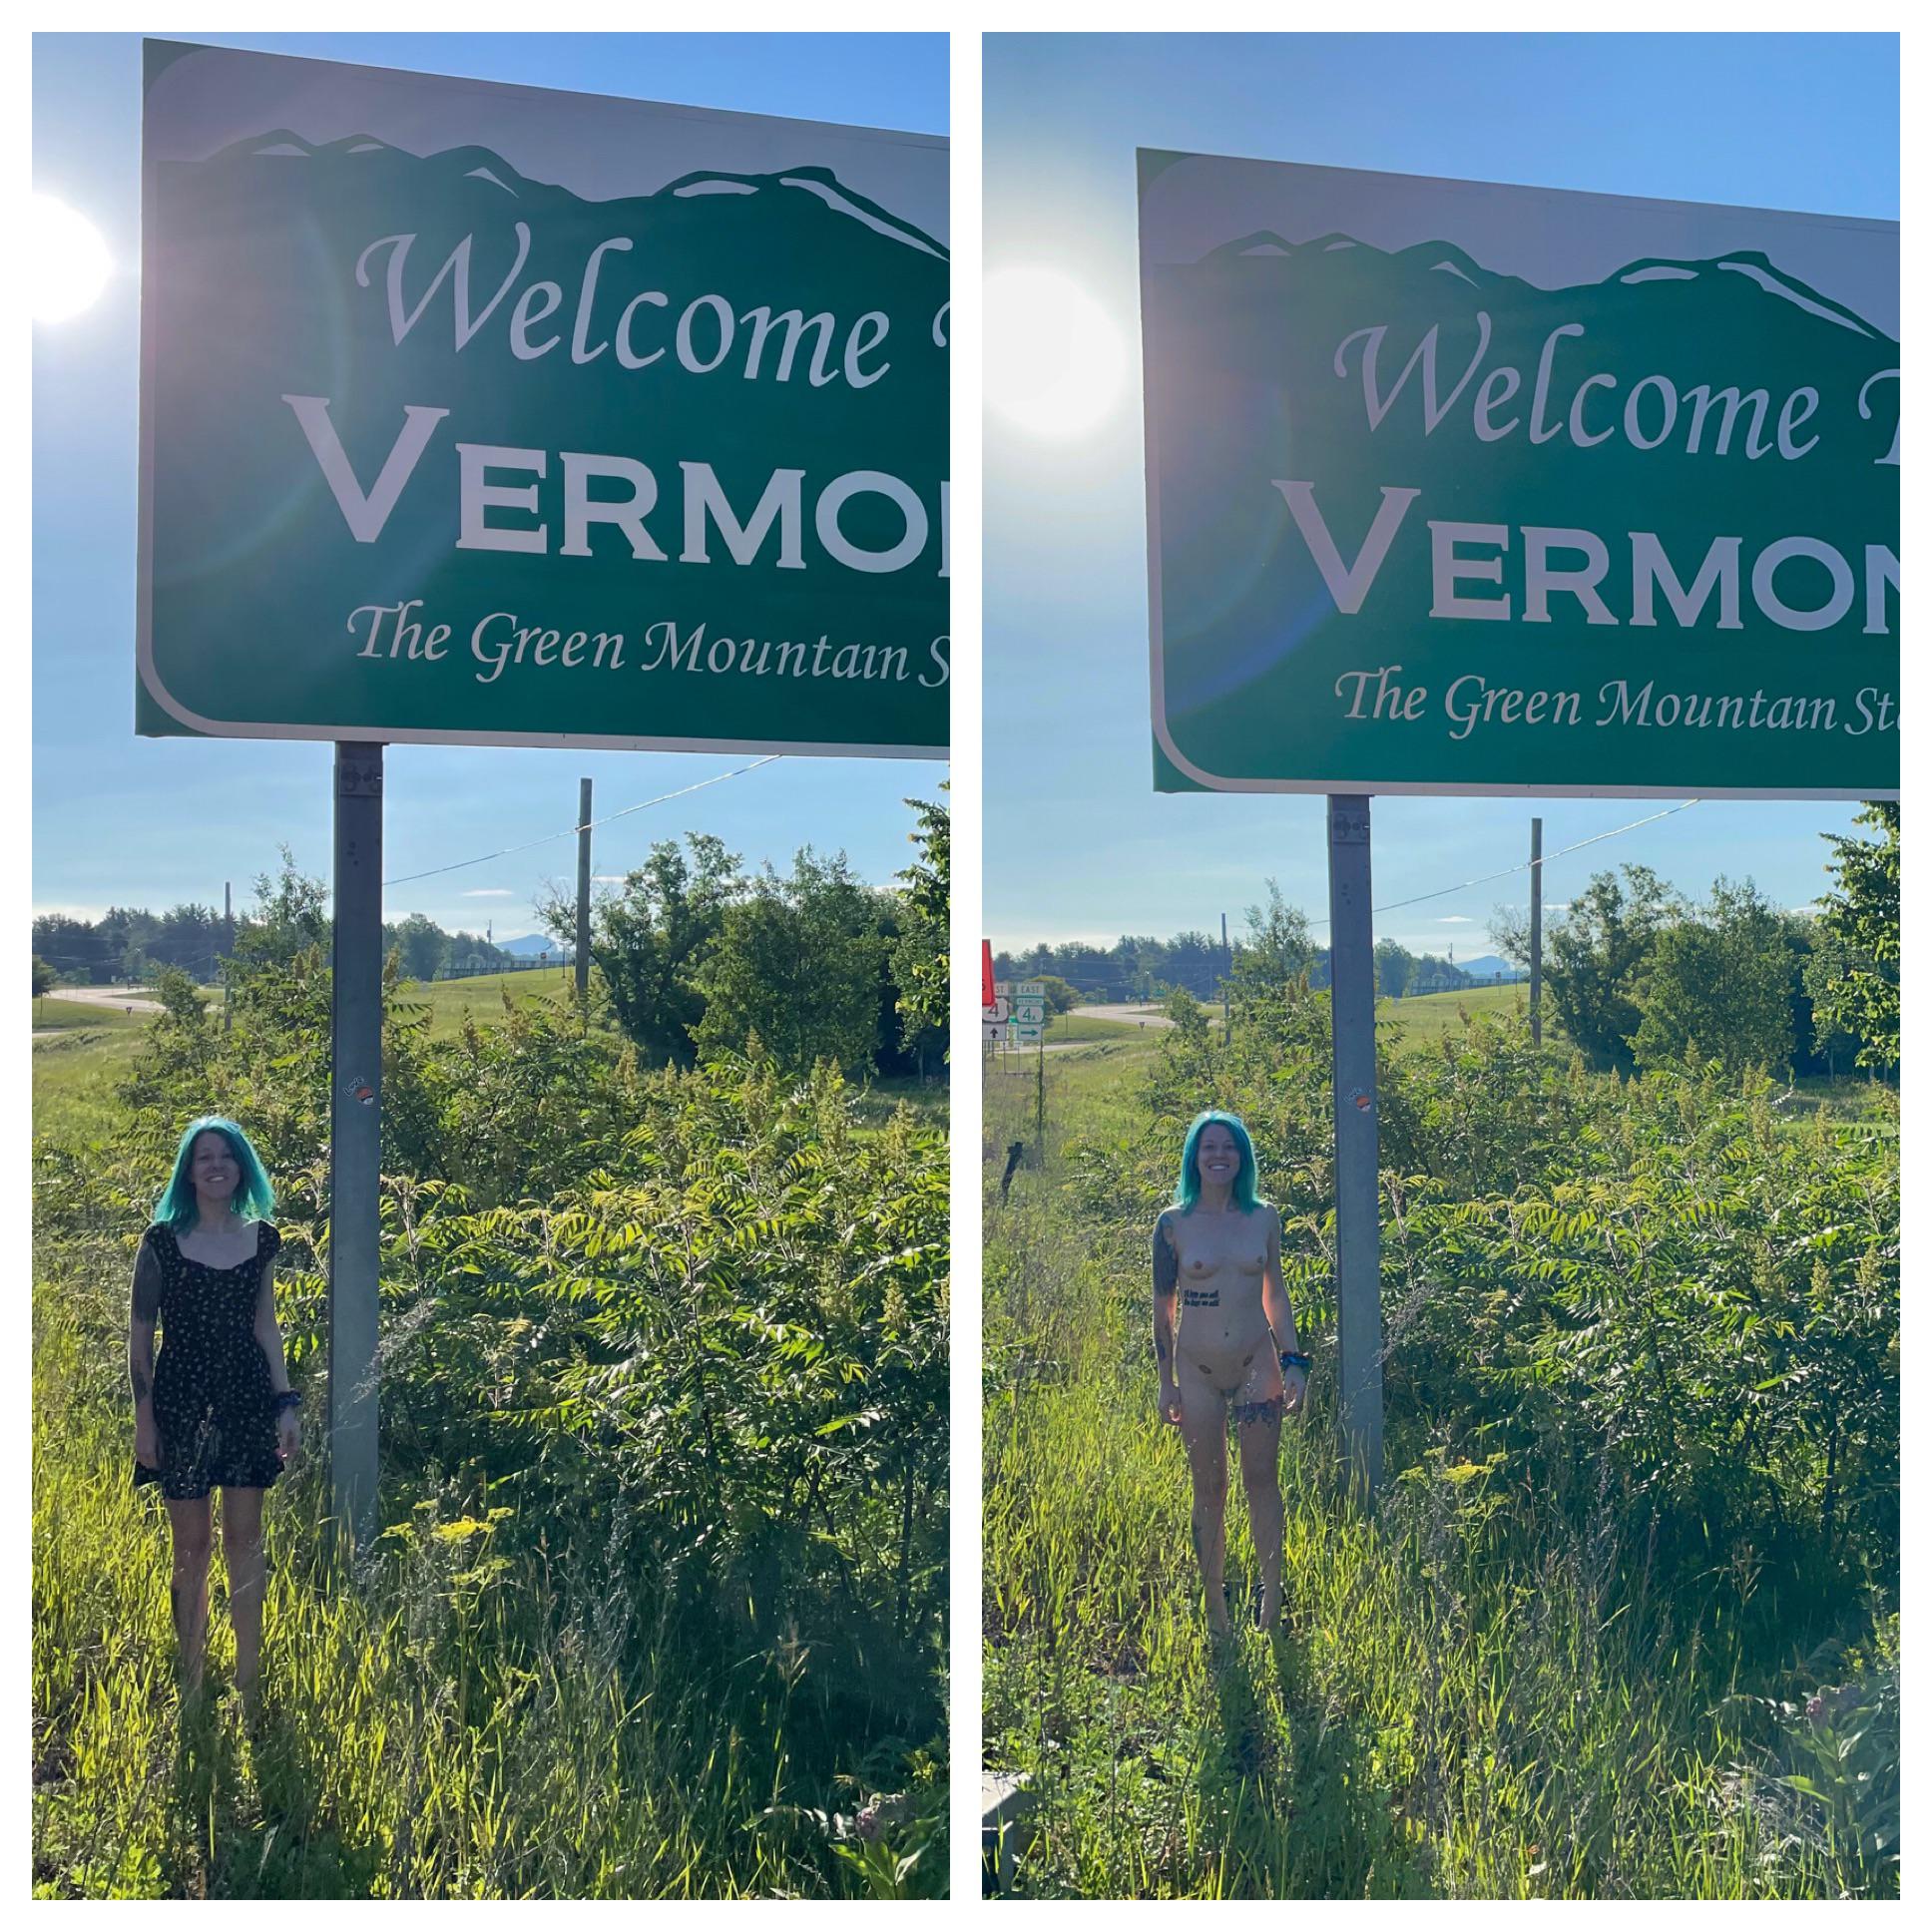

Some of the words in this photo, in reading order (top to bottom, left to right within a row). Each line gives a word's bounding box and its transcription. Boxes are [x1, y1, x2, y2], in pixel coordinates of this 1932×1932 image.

[356, 222, 891, 389] Welcome
[1334, 310, 1820, 462] Welcome
[281, 394, 950, 578] VERMO
[346, 600, 451, 660] The
[470, 612, 626, 684] Green
[642, 621, 910, 682] Mountain
[1334, 666, 1428, 723] The
[1444, 675, 1582, 739] Green
[1596, 680, 1837, 730] Mountain
[1843, 687, 1900, 735] St
[988, 1003, 1000, 1018] 4
[1021, 985, 1040, 994] EAST
